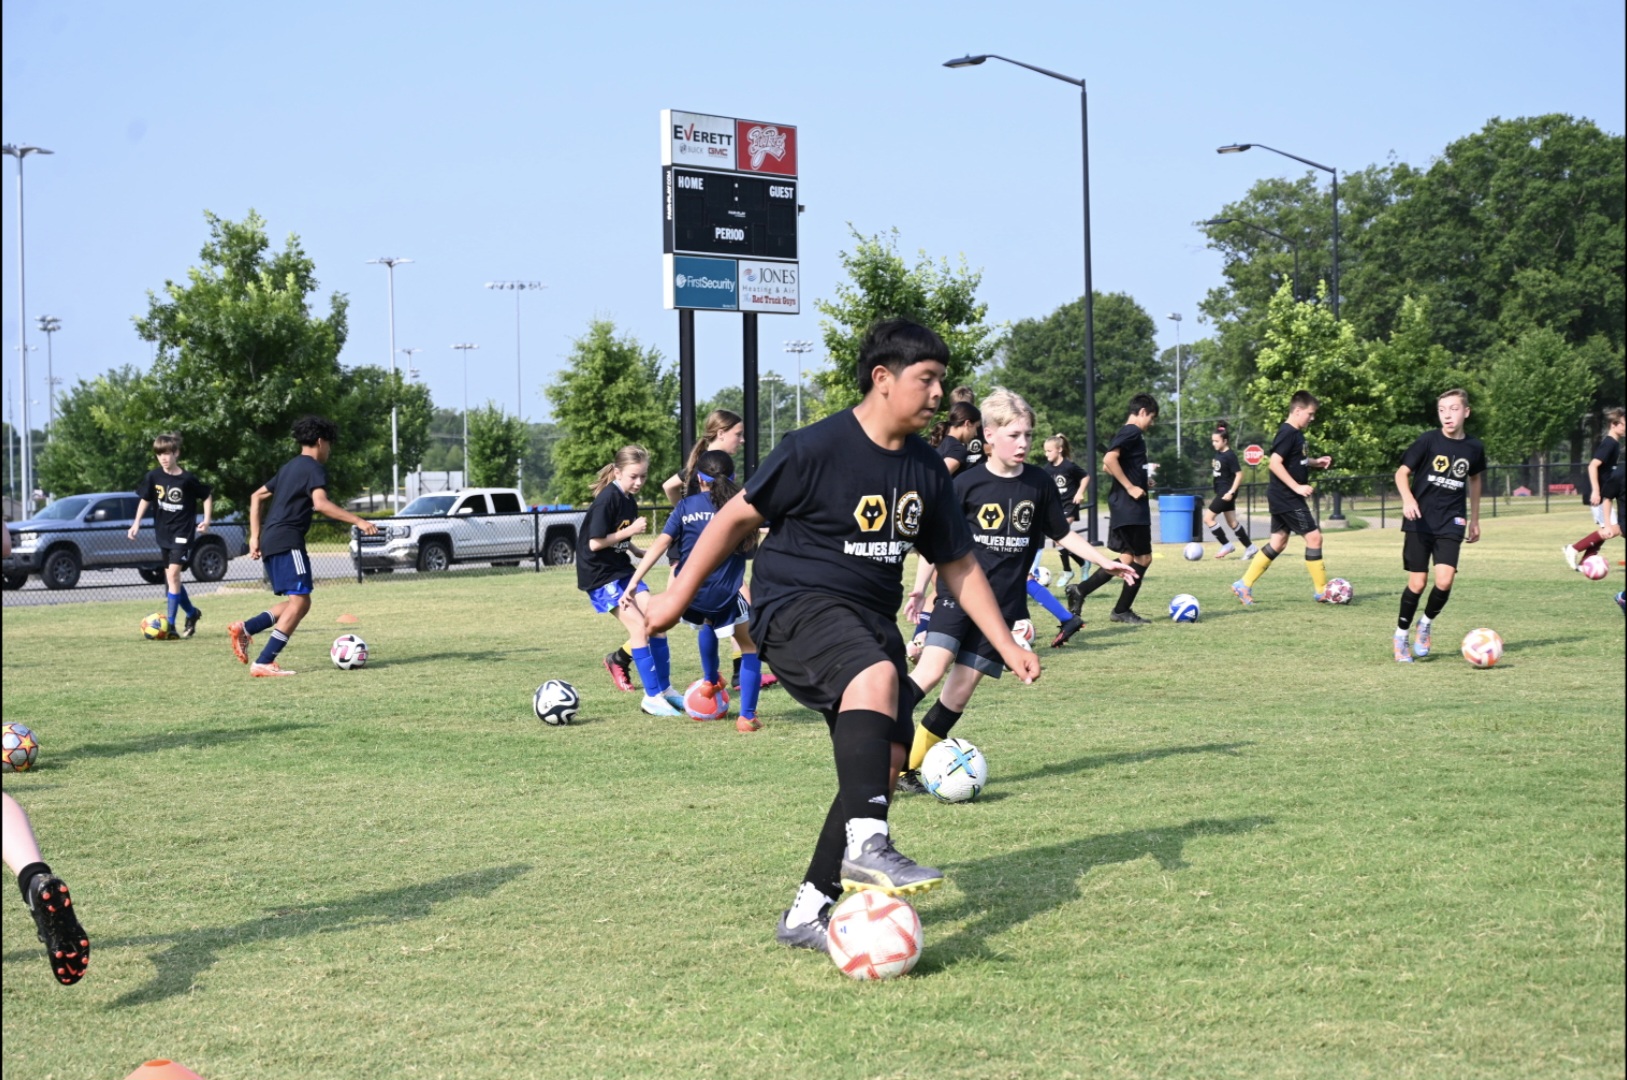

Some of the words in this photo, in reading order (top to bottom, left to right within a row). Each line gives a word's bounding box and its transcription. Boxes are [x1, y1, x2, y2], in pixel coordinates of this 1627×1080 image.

[673, 123, 732, 145] EVERETT
[687, 146, 703, 154] BUICK
[708, 147, 728, 156] GMC
[678, 176, 703, 190] HOME
[769, 185, 794, 199] GUEST
[715, 227, 745, 241] PERIOD
[759, 267, 796, 284] JONES
[687, 275, 736, 292] FirstSecurity
[742, 285, 772, 294] Heating
[752, 294, 764, 304] Red
[764, 295, 781, 305] Truck
[782, 296, 797, 307] Guys
[1246, 451, 1263, 459] STOP
[973, 533, 1006, 547] WOLVES
[843, 540, 888, 557] WOLVES
[884, 555, 897, 564] THE
